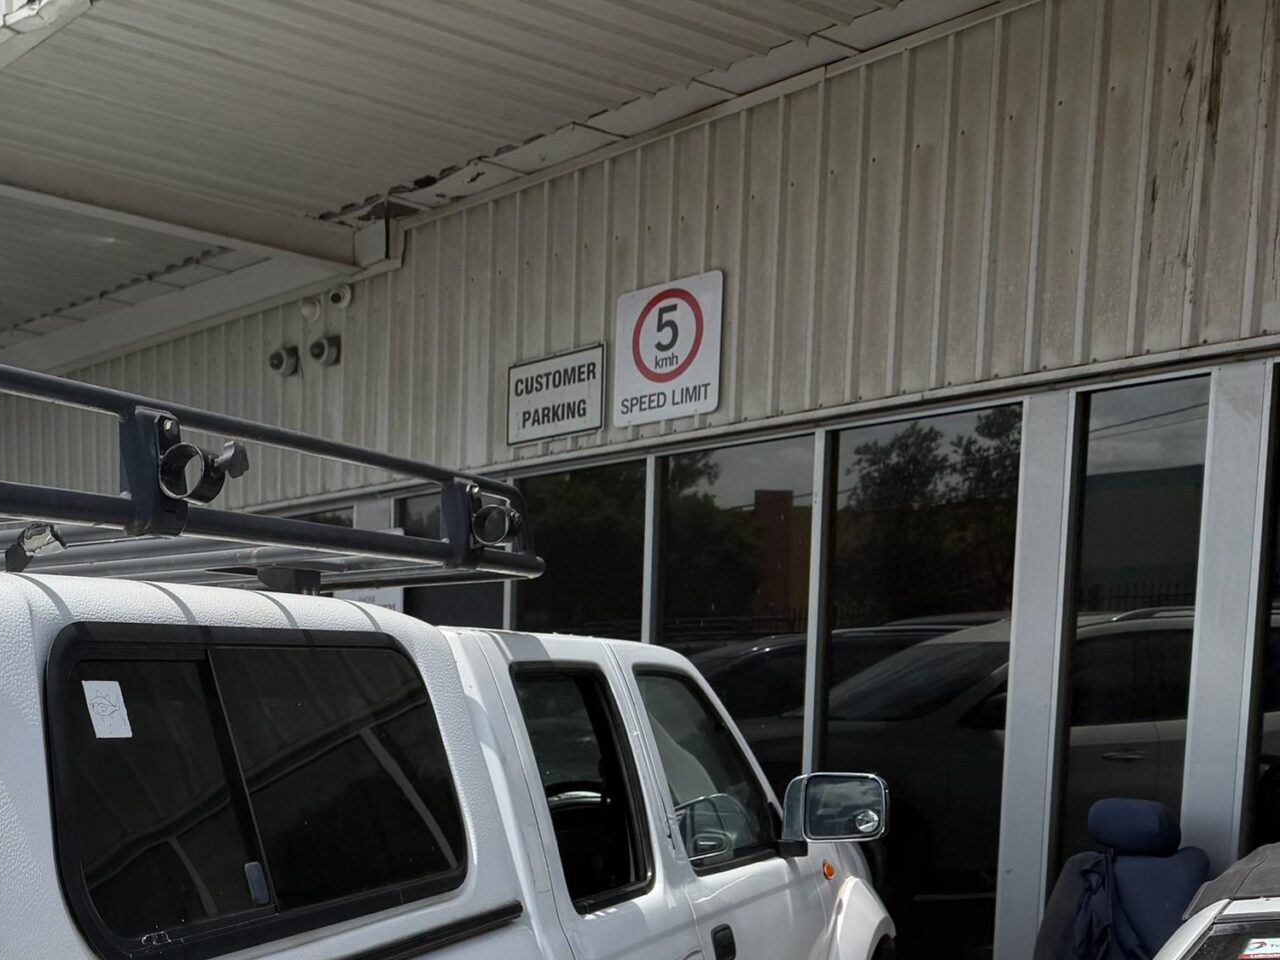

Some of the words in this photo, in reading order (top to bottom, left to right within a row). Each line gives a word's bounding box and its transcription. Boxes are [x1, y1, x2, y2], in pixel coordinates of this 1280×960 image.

[654, 303, 679, 352] 5
[654, 352, 679, 370] kmh
[514, 362, 597, 397] CUSTOMER
[522, 399, 587, 429] PARKING
[620, 391, 667, 415] SPEED
[671, 383, 712, 406] LIMIT
